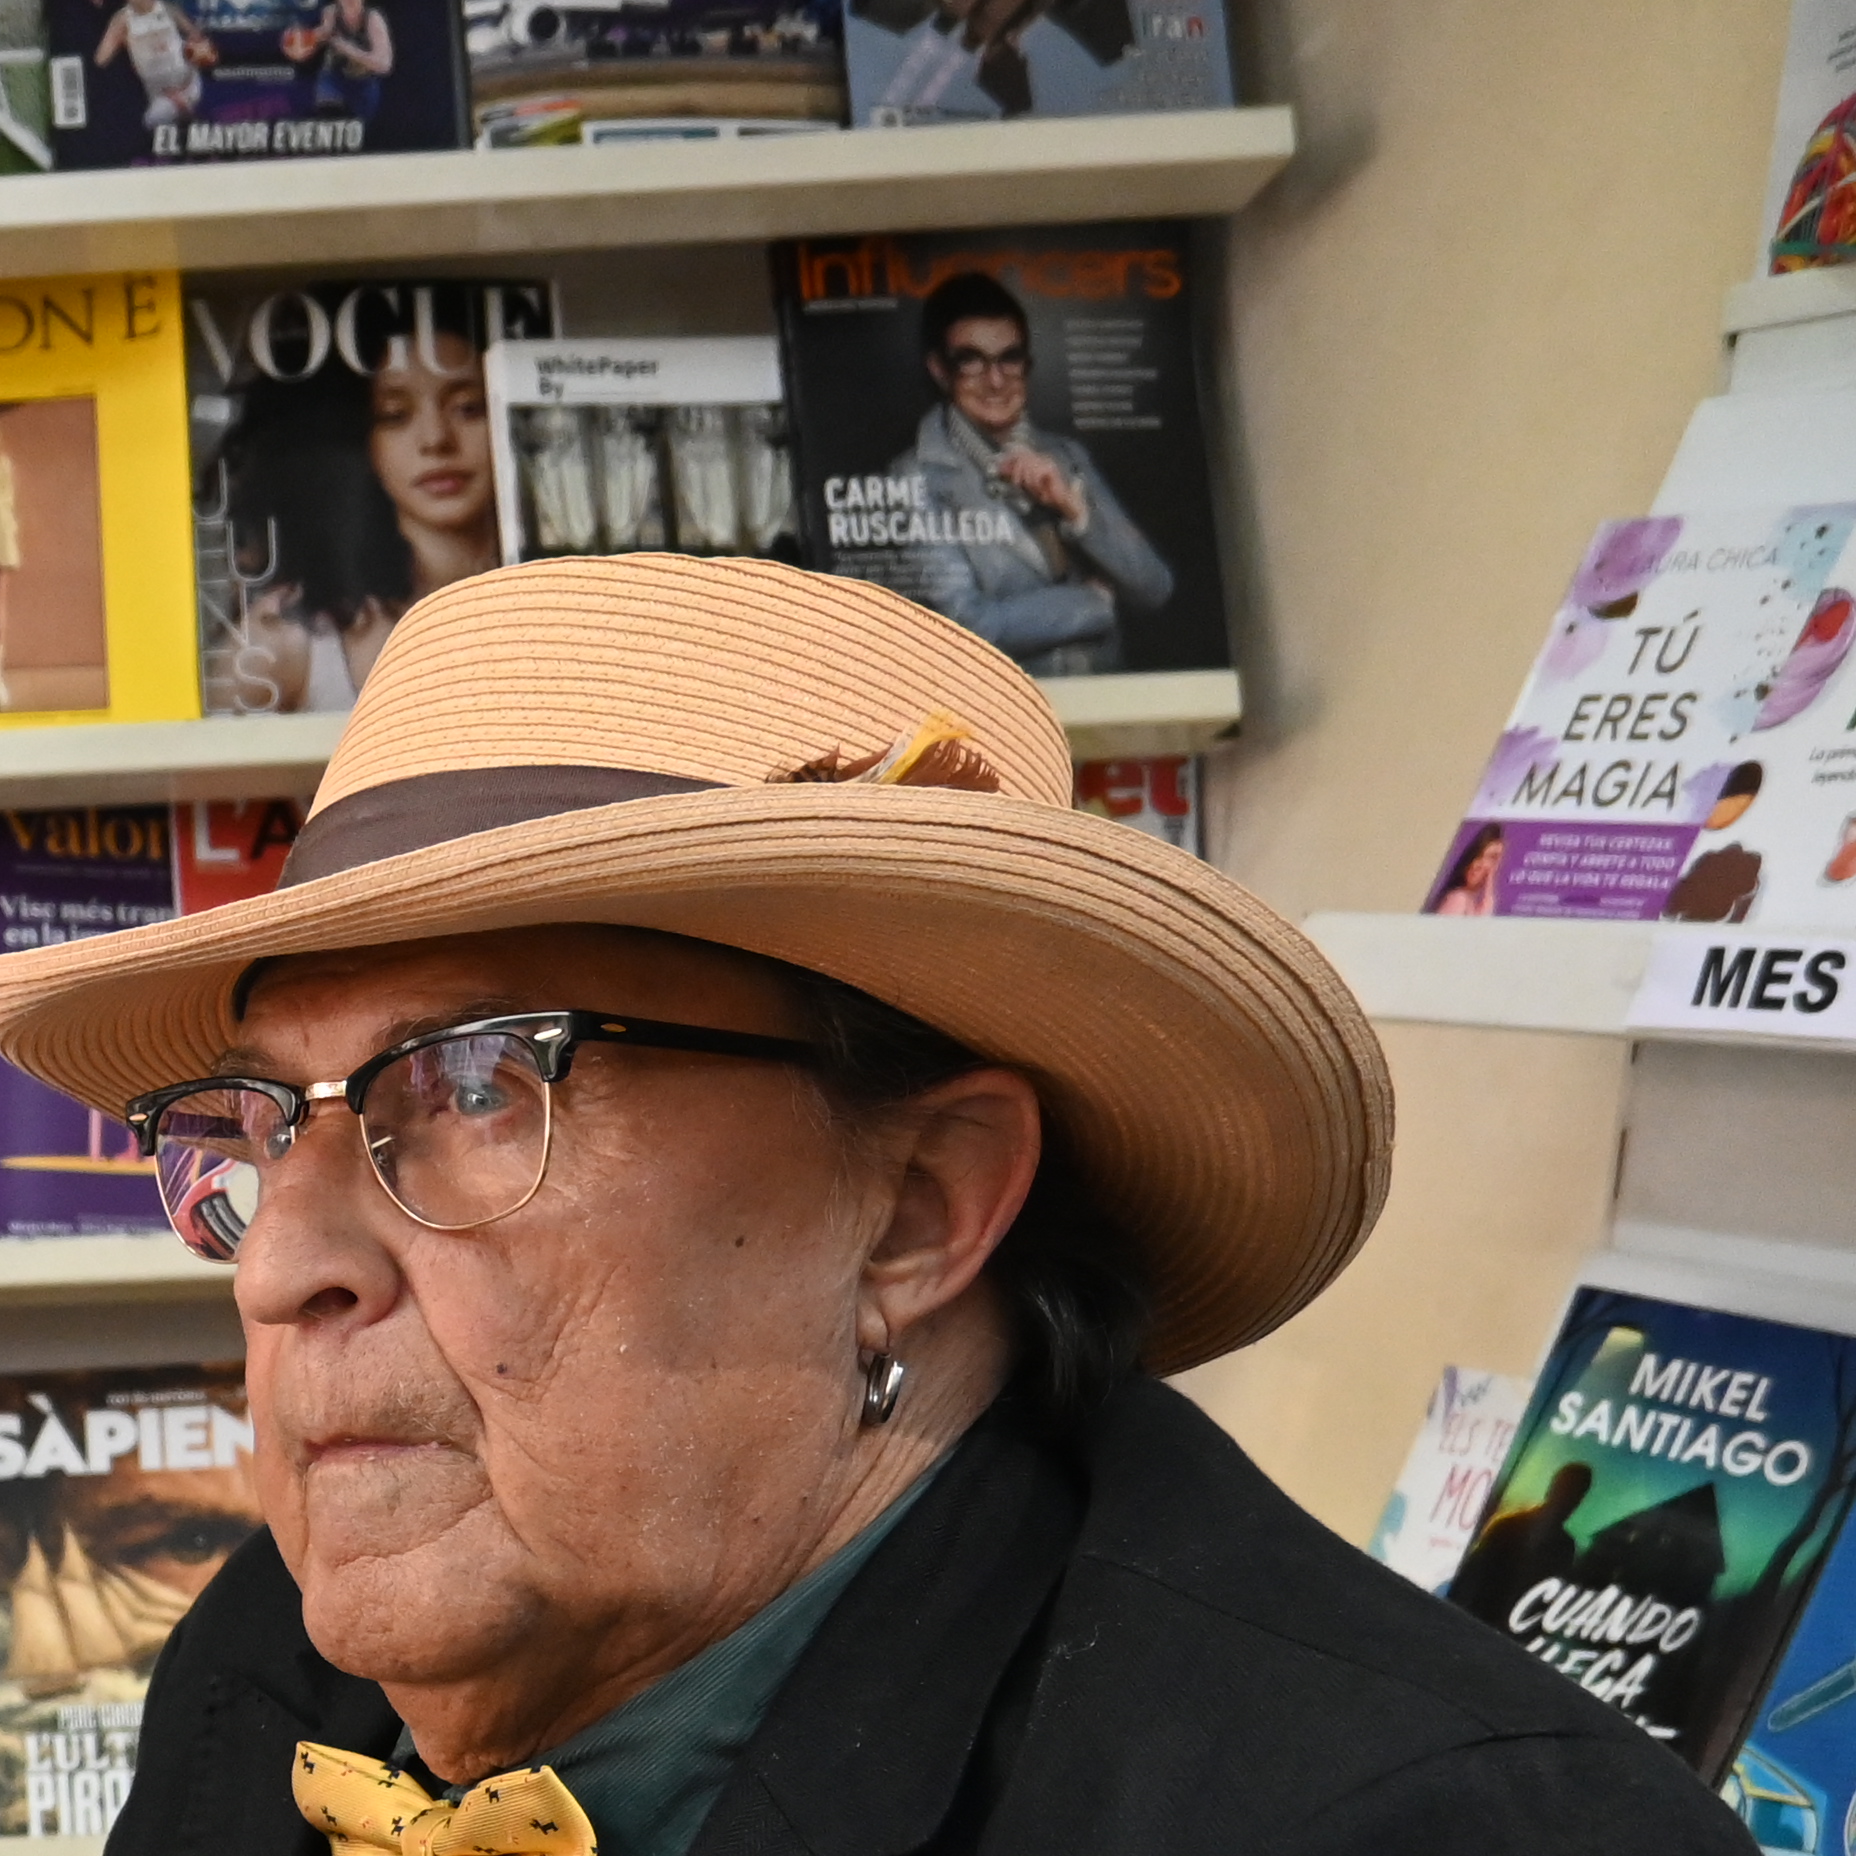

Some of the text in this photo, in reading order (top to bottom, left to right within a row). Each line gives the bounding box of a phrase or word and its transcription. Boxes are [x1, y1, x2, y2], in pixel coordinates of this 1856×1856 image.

[153, 119, 364, 155] EL MAYOR EVENTO
[189, 283, 550, 384] VOGUE
[535, 356, 658, 378] WhitePaper
[537, 378, 565, 400] By
[825, 477, 927, 511] CARME
[828, 512, 1013, 547] RUSCALLEDA
[1706, 546, 1778, 571] CHICA
[1628, 610, 1701, 675] TÚ
[1563, 692, 1697, 741] ERES
[1513, 760, 1682, 810] MAGIA
[62, 896, 111, 920] més
[1691, 946, 1846, 1013] MES
[1629, 1353, 1774, 1424] MIKEL
[1550, 1392, 1810, 1486] SANTIAGO
[1507, 1578, 1701, 1652] CUANDO
